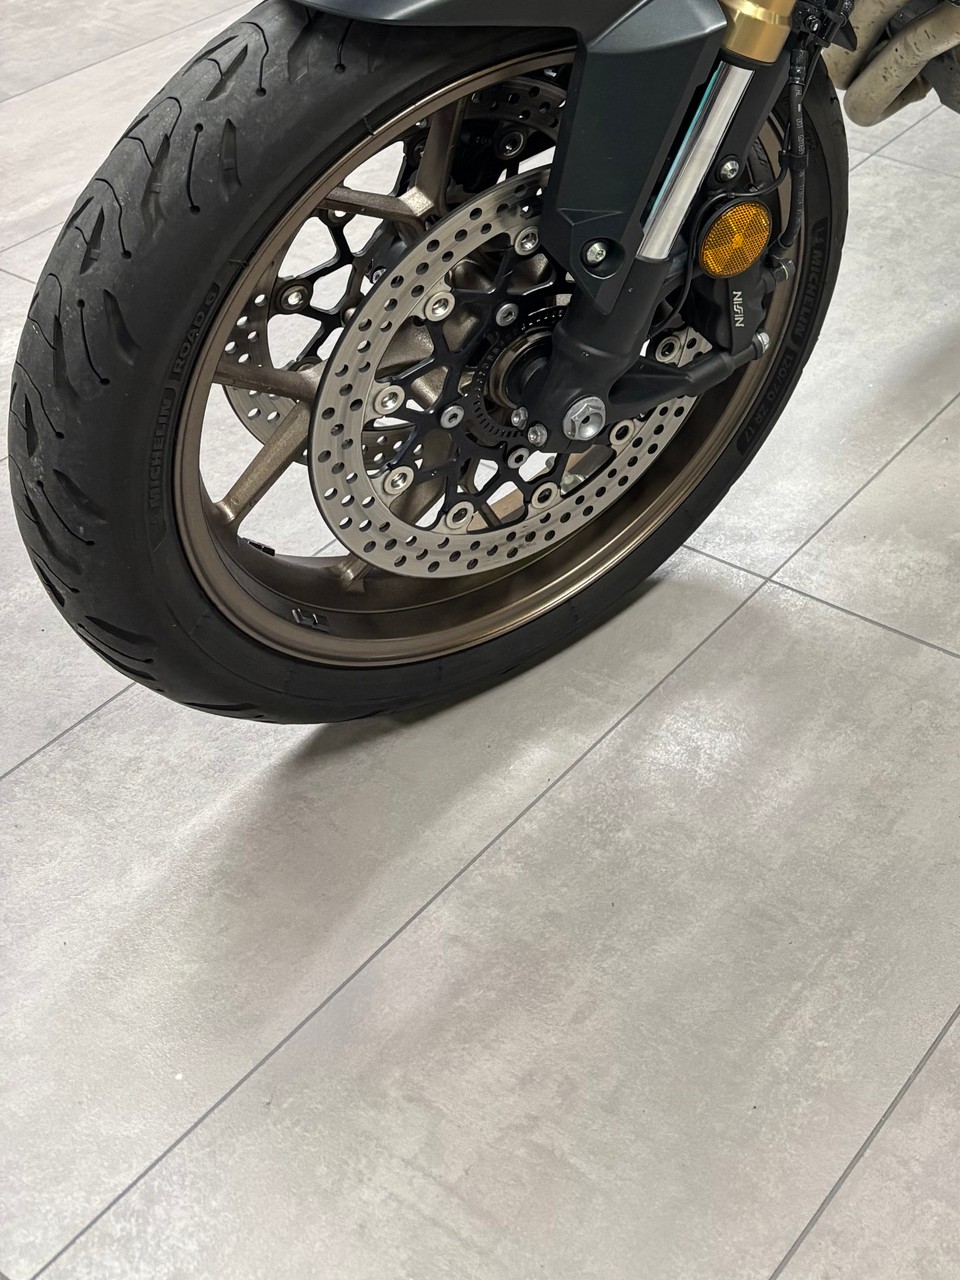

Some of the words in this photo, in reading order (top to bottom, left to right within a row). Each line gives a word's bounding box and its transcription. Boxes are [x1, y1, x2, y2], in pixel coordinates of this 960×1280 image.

[793, 249, 824, 337] MICHELIN
[149, 397, 172, 510] MICHELIN
[173, 310, 206, 375] ROAD
[204, 290, 217, 307] 6
[766, 351, 795, 402] 120/70
[743, 425, 757, 443] 17
[752, 403, 769, 426] ZR
